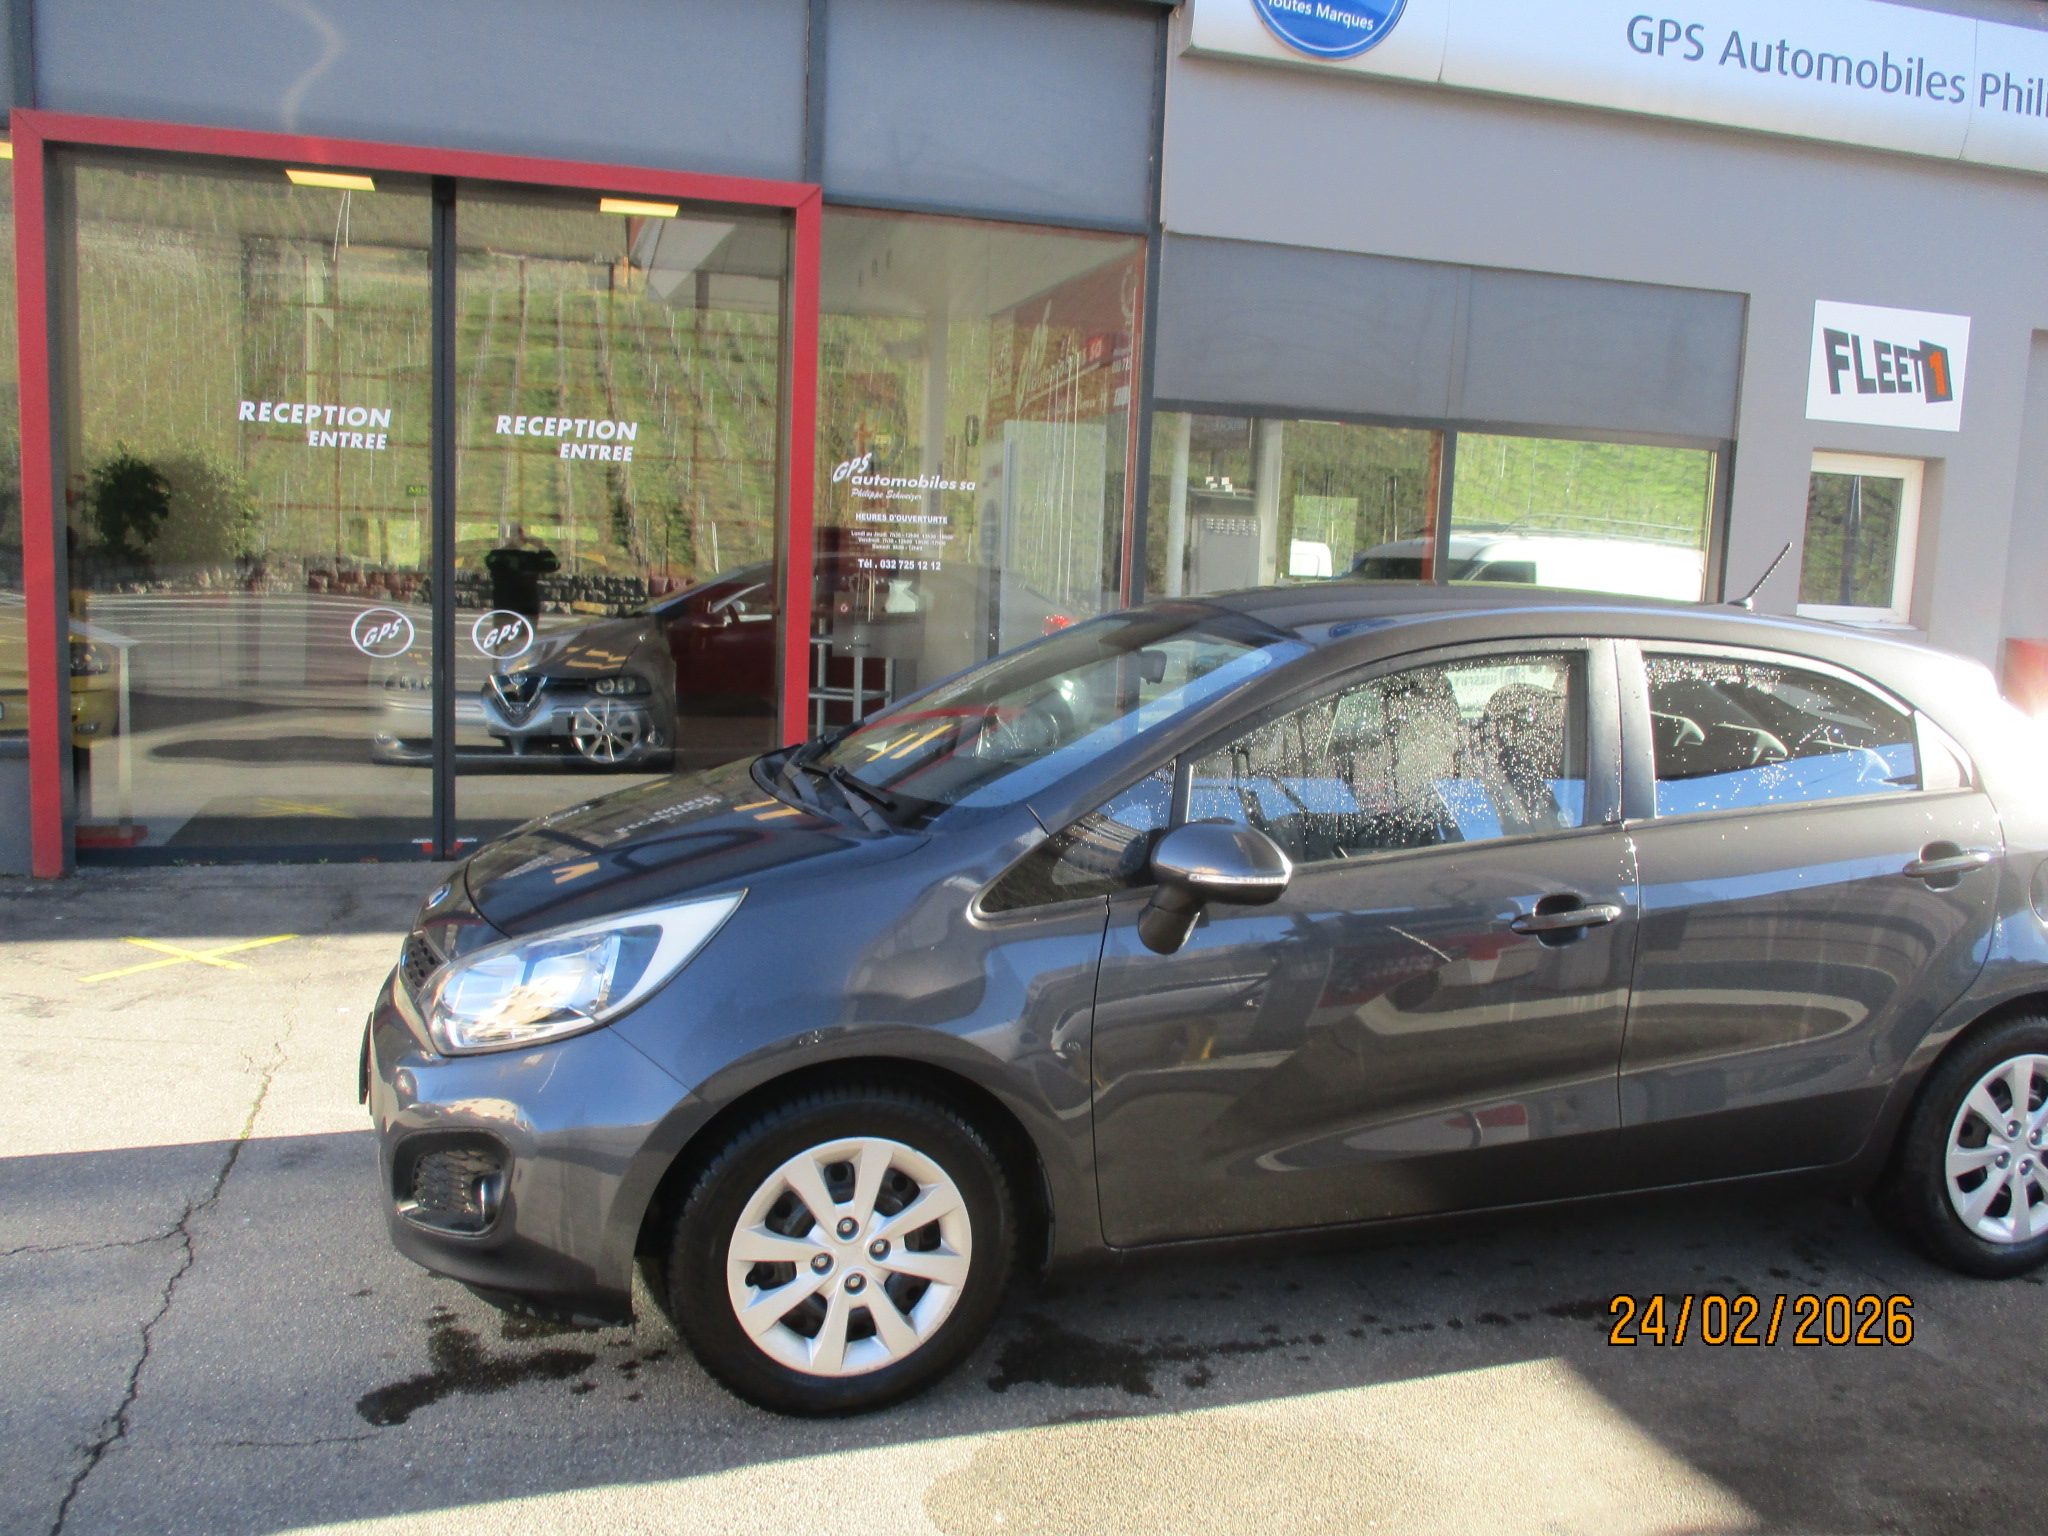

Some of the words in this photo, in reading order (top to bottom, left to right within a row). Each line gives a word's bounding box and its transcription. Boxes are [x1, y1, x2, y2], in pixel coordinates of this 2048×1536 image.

[1315, 3, 1375, 31] Marques
[1626, 14, 1705, 61] GPS
[1719, 29, 1966, 104] Automobiles
[238, 400, 392, 428] RECEPTION
[496, 414, 638, 442] RECEPTION
[308, 430, 388, 451] ENTREE
[559, 443, 634, 463] ENTREE
[832, 452, 873, 483] GPS
[851, 473, 957, 490] automobiles
[959, 480, 976, 491] sa
[851, 487, 884, 500] Philippe
[855, 512, 887, 522] HEURES
[857, 558, 873, 569] Tél
[880, 559, 897, 570] 032
[898, 559, 915, 570] 725
[917, 560, 928, 570] 12
[931, 561, 941, 571] 12
[362, 618, 403, 648] GPS
[483, 620, 523, 649] GPS
